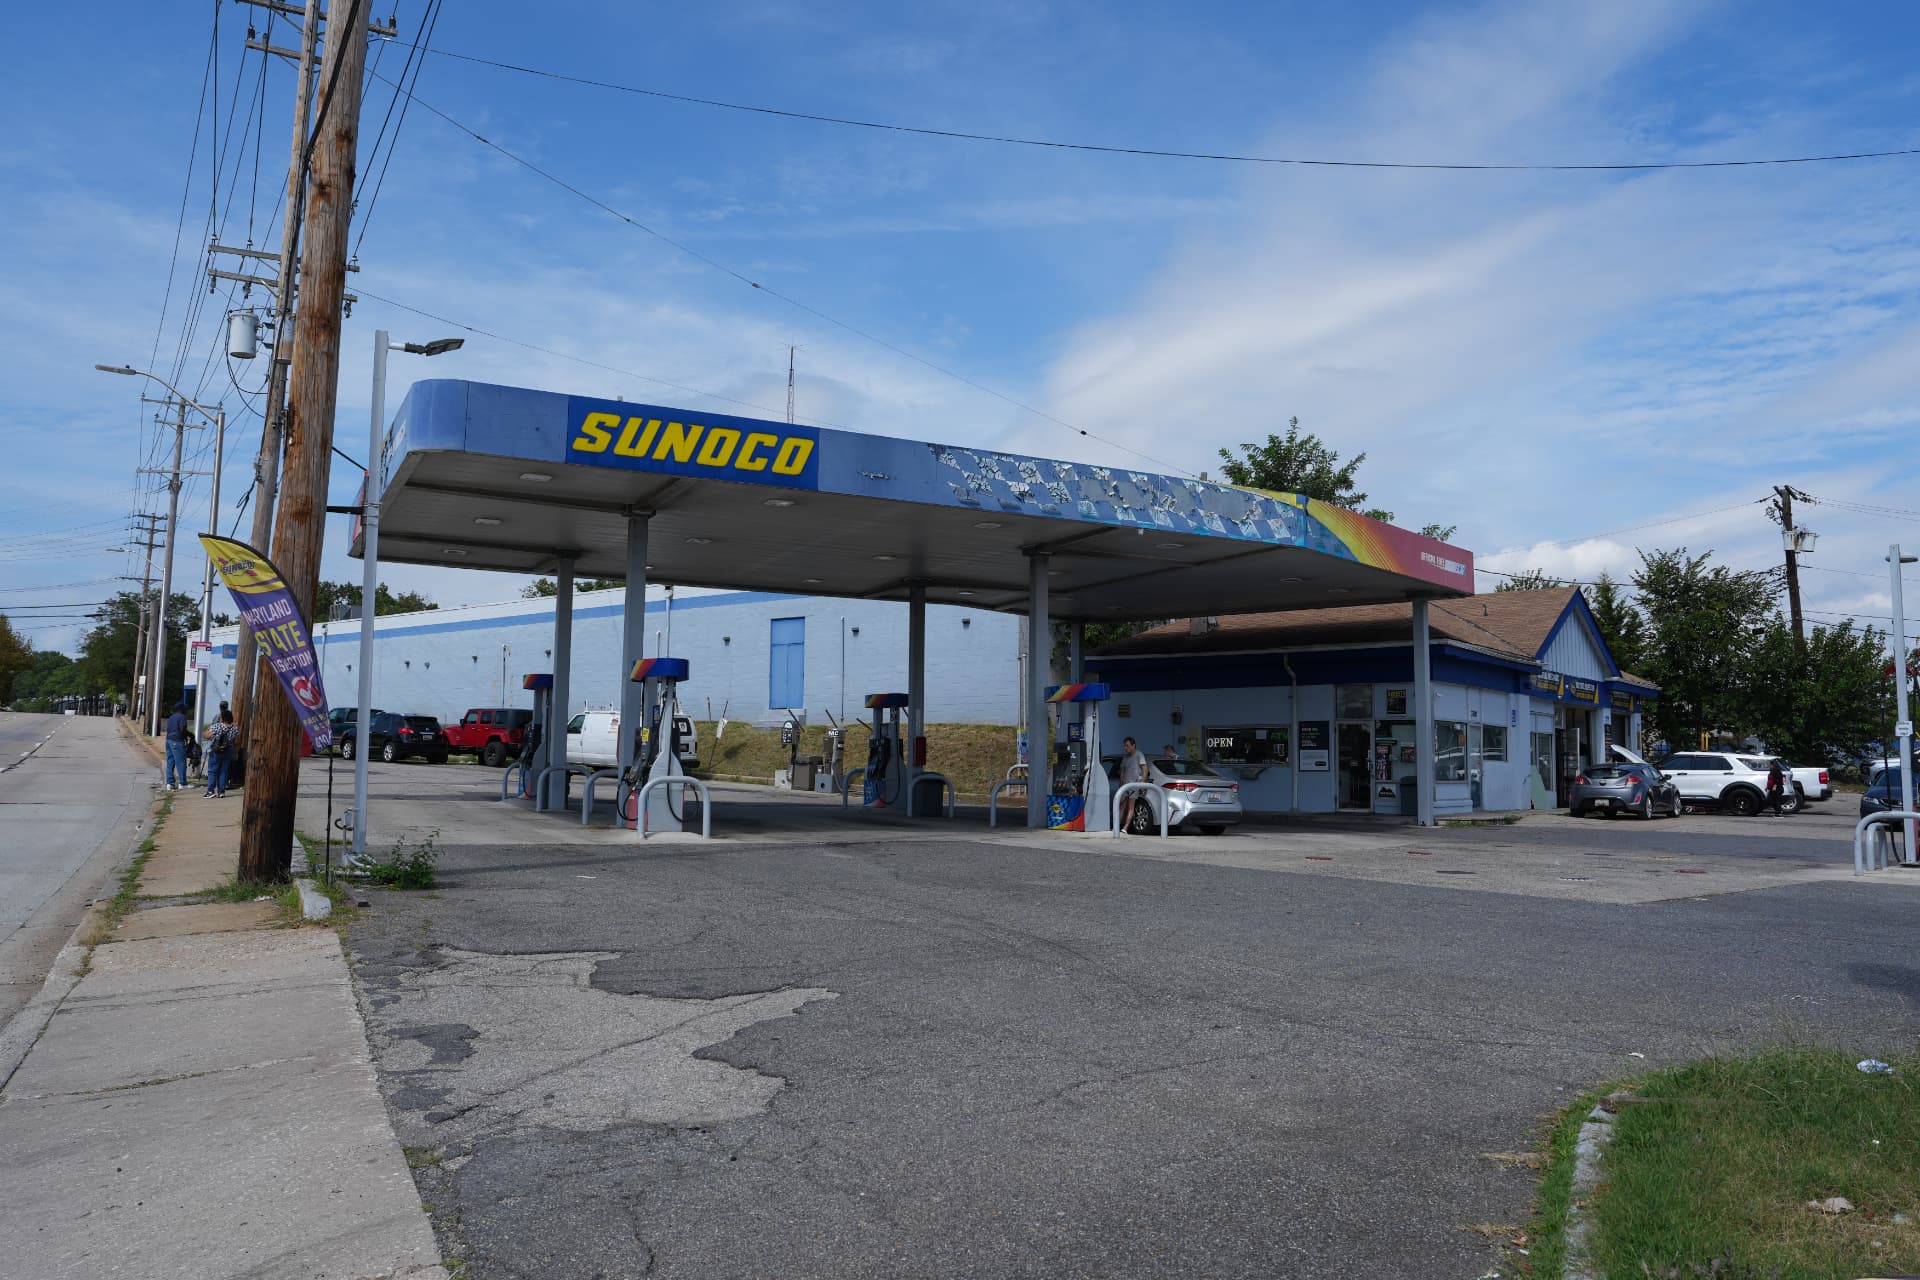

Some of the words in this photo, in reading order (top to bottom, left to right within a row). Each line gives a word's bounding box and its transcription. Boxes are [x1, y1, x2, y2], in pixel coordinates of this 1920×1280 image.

[571, 411, 815, 475] SUNOCO
[242, 599, 292, 626] MARYLAND
[1208, 738, 1234, 748] OPEN
